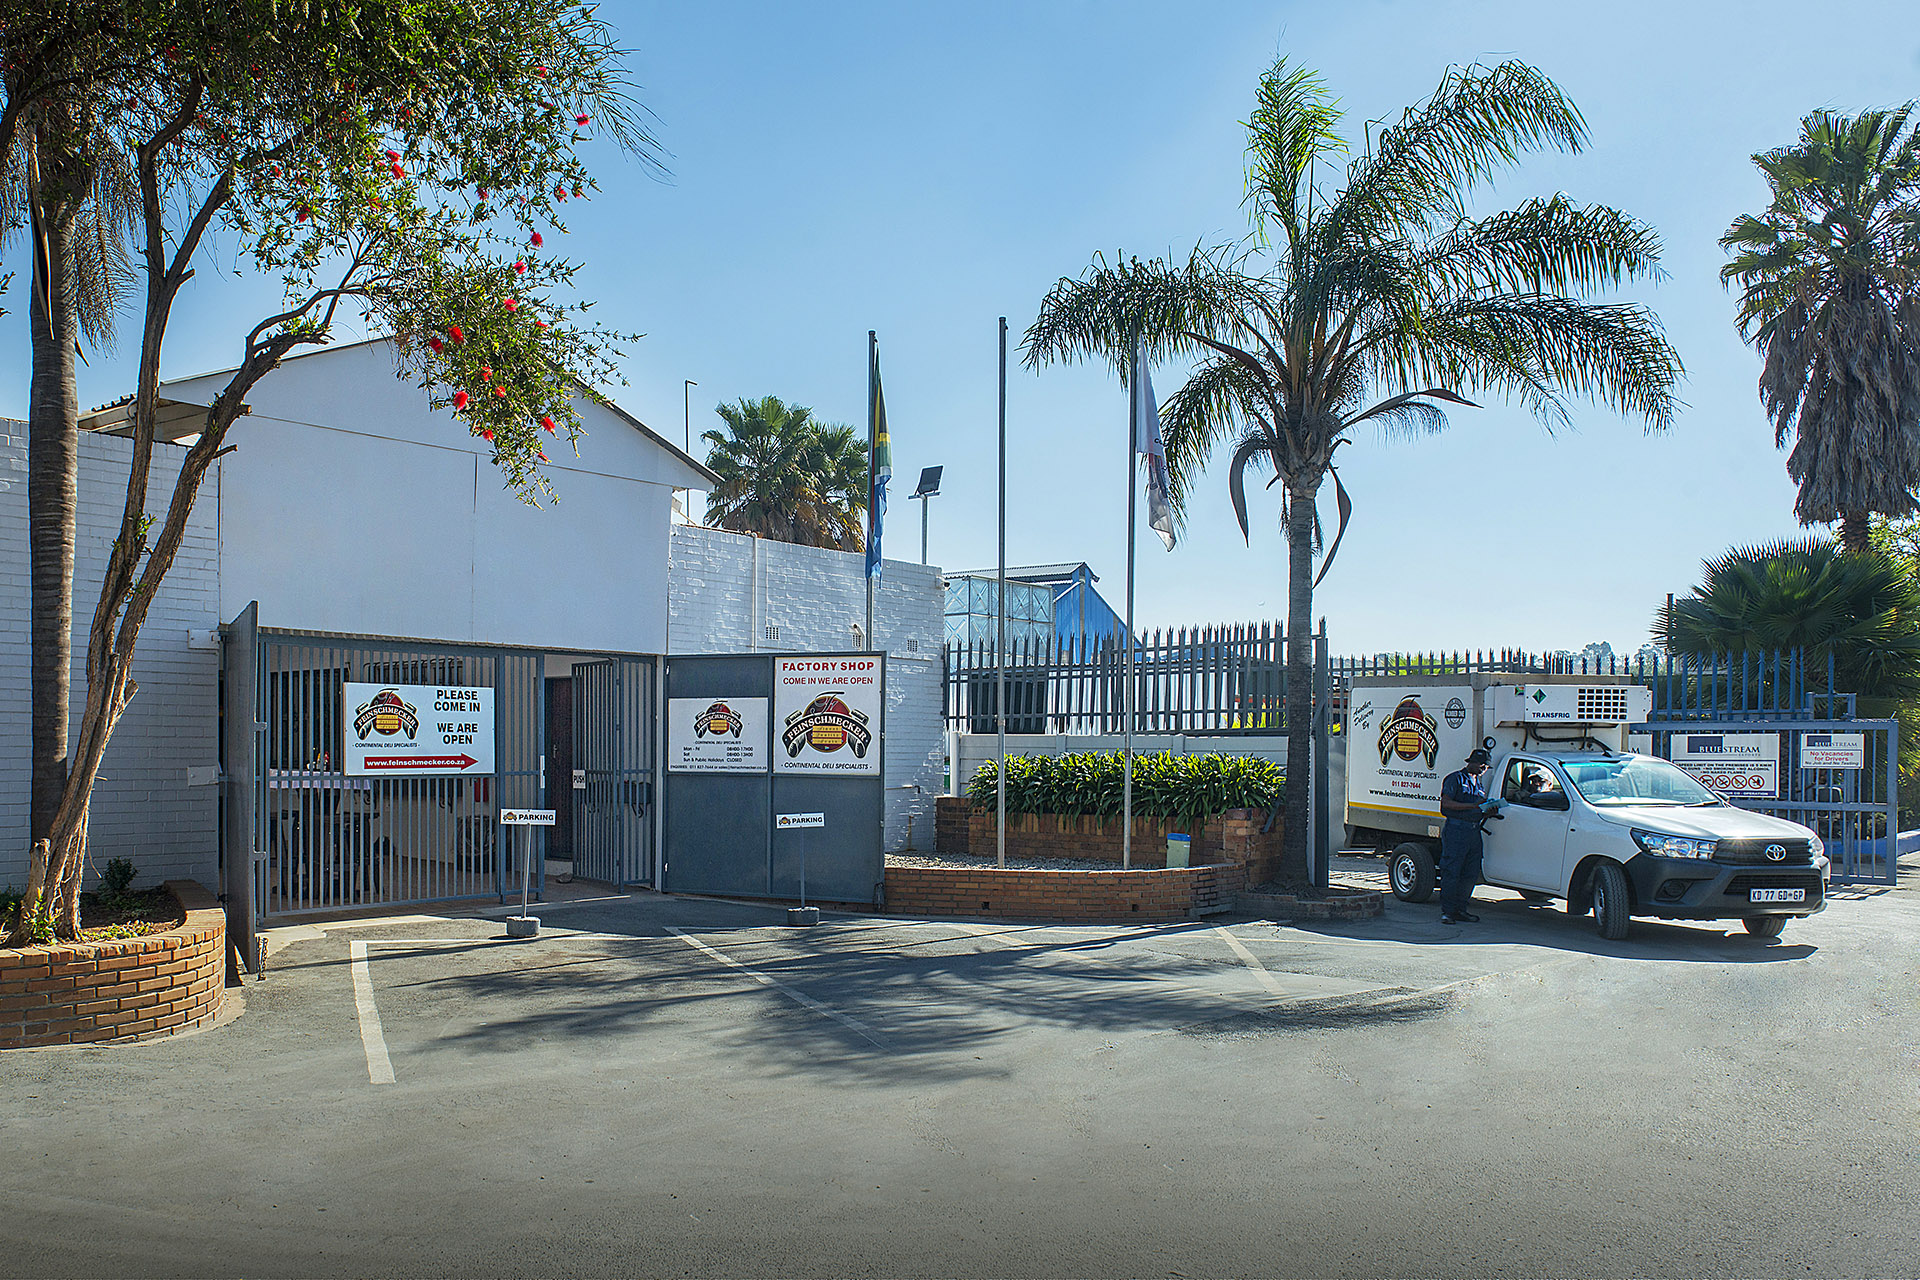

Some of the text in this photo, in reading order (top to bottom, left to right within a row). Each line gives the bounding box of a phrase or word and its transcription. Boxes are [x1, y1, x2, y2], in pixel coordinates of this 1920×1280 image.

[782, 661, 874, 671] FACTORY SHOP
[783, 677, 873, 685] COME IN WE ARE OPEN
[436, 689, 478, 701] PLEASE
[434, 701, 480, 712] COME IN
[358, 706, 416, 726] FEINSCHMECKER
[437, 722, 478, 733] WE ARE
[787, 715, 867, 740] FEINSCHMECKER
[443, 734, 473, 745] OPEN
[1381, 721, 1436, 749] FEINSCHMECKER
[1764, 890, 1775, 901] 77
[1793, 890, 1803, 901] GP
